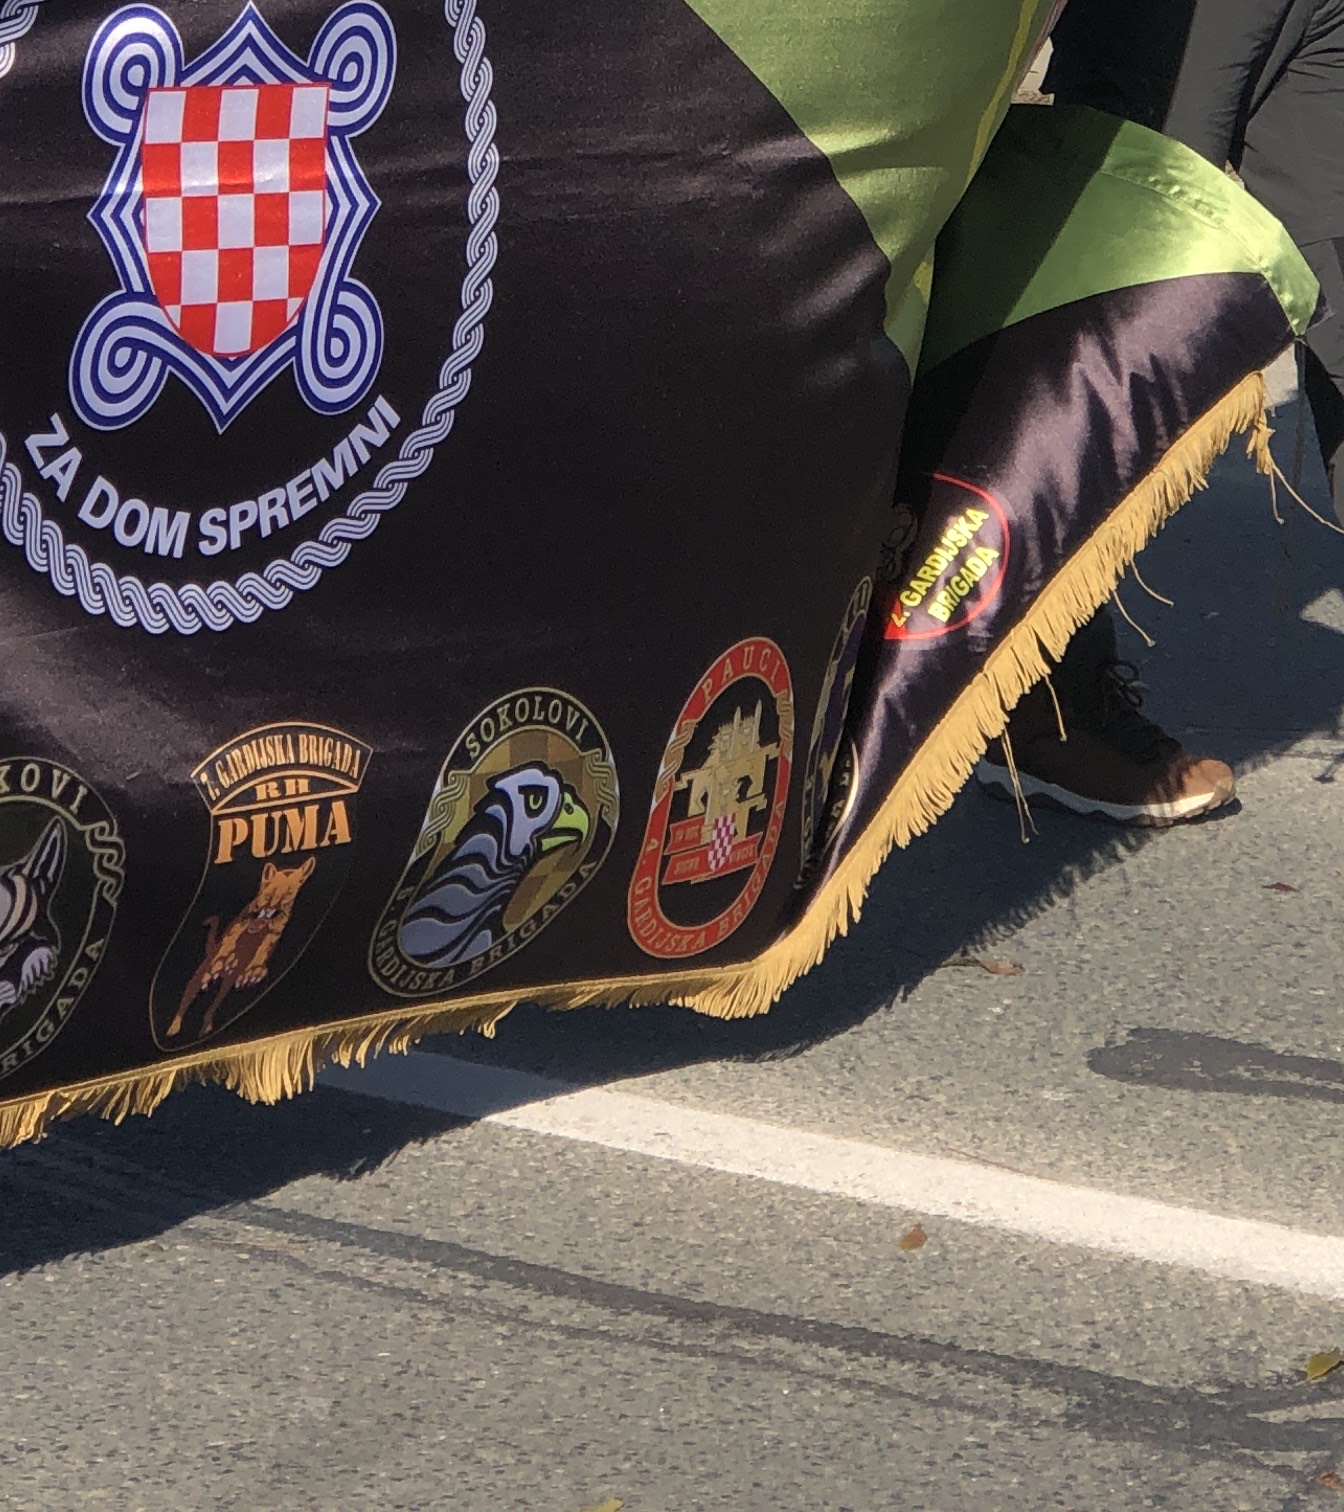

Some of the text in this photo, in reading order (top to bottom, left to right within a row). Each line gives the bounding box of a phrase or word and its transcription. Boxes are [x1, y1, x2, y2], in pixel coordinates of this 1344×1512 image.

[23, 395, 402, 560] ZA DOM SPREMNI
[899, 506, 990, 607] GARDIJSKA
[927, 545, 1000, 625] BRIGADA
[701, 646, 782, 702] PAUCI
[465, 695, 588, 760] SOKOLOVI
[215, 734, 295, 789] GARDIJSKA
[298, 734, 361, 779] BRIGADA
[214, 800, 352, 864] PUMA
